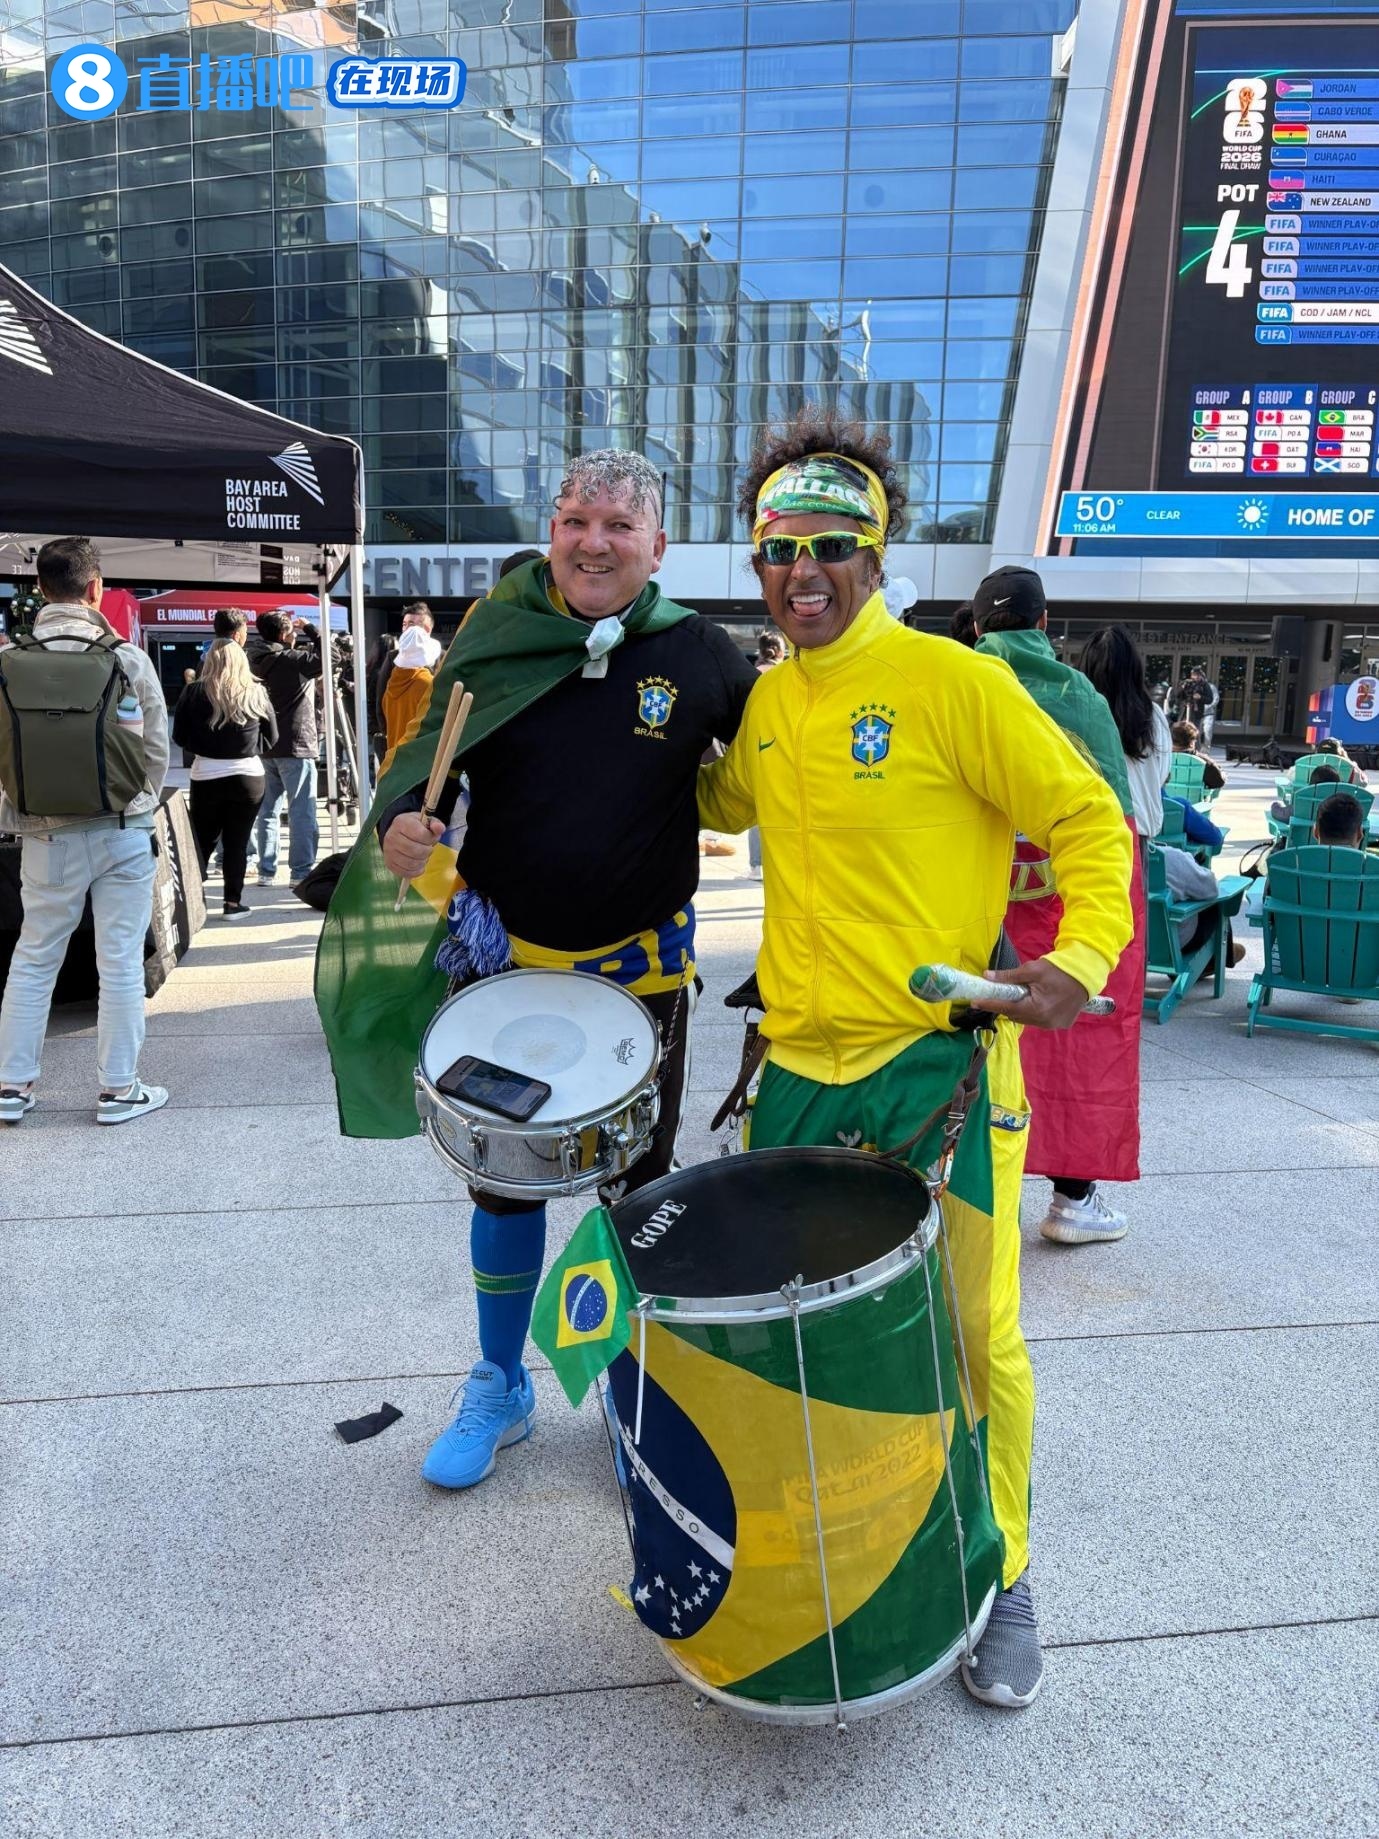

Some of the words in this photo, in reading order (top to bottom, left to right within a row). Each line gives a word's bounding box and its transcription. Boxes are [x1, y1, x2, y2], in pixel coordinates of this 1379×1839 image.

[1320, 84, 1357, 93] JORDAN
[1318, 107, 1343, 116] CABO
[1345, 107, 1373, 116] VERDE
[1316, 130, 1347, 139] GHANA
[1221, 152, 1262, 162] 2026
[1314, 152, 1357, 162] CURAÇAO
[1312, 175, 1335, 184] HAITI
[1217, 184, 1260, 202] POT
[1310, 198, 1330, 206] NEW
[1332, 198, 1372, 206] ZEALAND
[1270, 219, 1296, 228] FIFA
[1308, 220, 1342, 228] WINNER
[1268, 242, 1294, 251] FIFA
[1306, 242, 1340, 251] WINNER
[1205, 210, 1252, 297] 4
[1266, 264, 1292, 273] FIFA
[1304, 264, 1338, 273] WINNER
[1264, 286, 1290, 295] FIFA
[1302, 286, 1336, 295] WINNER
[1262, 308, 1288, 318] FIFA
[1300, 308, 1318, 317] COD
[1327, 308, 1346, 317] JAM
[1355, 308, 1372, 317] NCL
[1260, 330, 1286, 340] FIFA
[1299, 330, 1333, 339] WINNER
[1334, 330, 1376, 339] PLAY-OFF
[1196, 390, 1230, 404] GROUP
[1242, 390, 1250, 404] A
[1258, 390, 1292, 404] GROUP
[1305, 390, 1313, 404] B
[1321, 390, 1355, 404] GROUP
[1368, 390, 1376, 404] C
[225, 479, 251, 496] BAY
[253, 480, 288, 497] AREA
[226, 496, 260, 512] HOST
[1146, 510, 1180, 520] CLEAR
[1288, 508, 1345, 526] HOME
[1348, 508, 1375, 526] OF
[227, 512, 300, 530] COMMITTEE
[1073, 524, 1098, 533] 11:06
[1100, 524, 1116, 533] AM
[157, 609, 167, 621] EL
[168, 609, 207, 621] MUNDIAL
[1168, 632, 1231, 644] ENTRANCE
[649, 700, 663, 708] CBF
[634, 727, 668, 740] BRASIL
[862, 734, 878, 742] CBF
[854, 771, 886, 780] BRASIL
[630, 1199, 688, 1250] GOPE
[831, 1439, 896, 1476] WORLD
[898, 1421, 925, 1446] CUP
[874, 1443, 922, 1480] 2022
